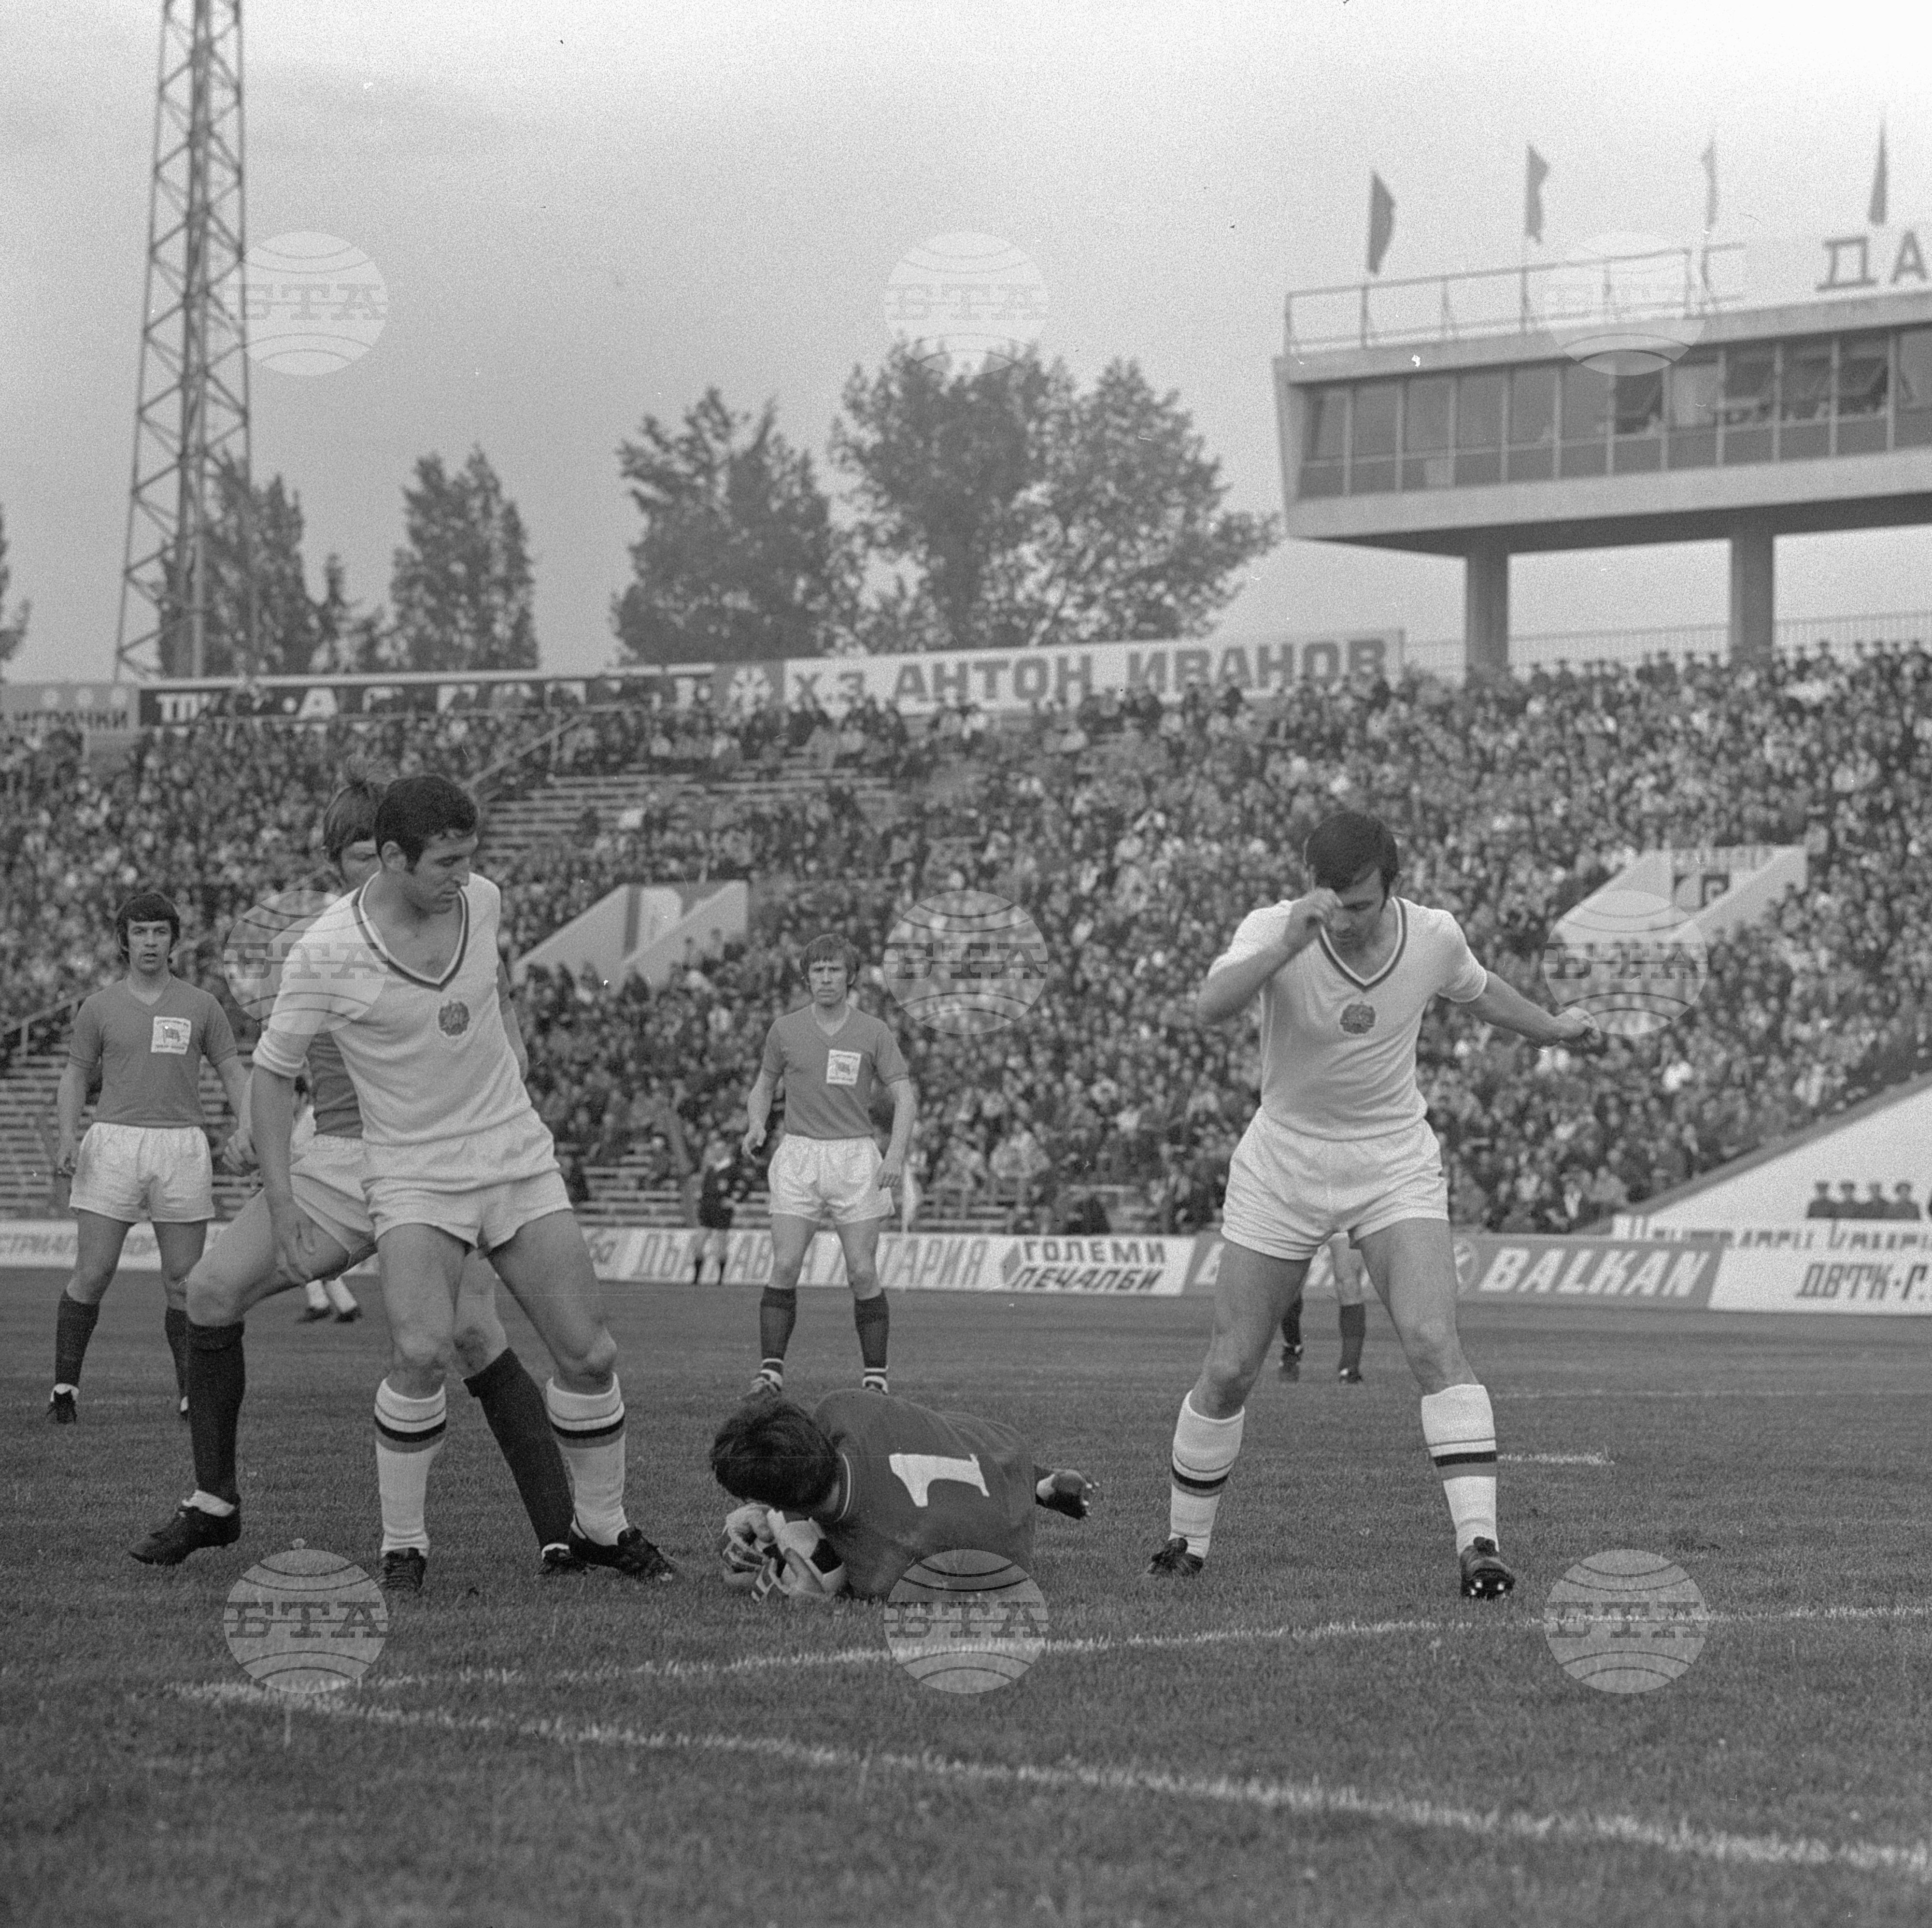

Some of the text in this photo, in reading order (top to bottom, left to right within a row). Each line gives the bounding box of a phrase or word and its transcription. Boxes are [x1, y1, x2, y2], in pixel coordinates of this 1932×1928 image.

[893, 654, 1092, 704] АНТОН
[1128, 639, 1385, 695] ИВАНОВ
[1023, 1240, 1166, 1263] ГОЛЕМИ
[1477, 1247, 1710, 1297] BALKAN
[1010, 1267, 1164, 1290] ПЕЧАЛБИ
[889, 1453, 990, 1507] 1
